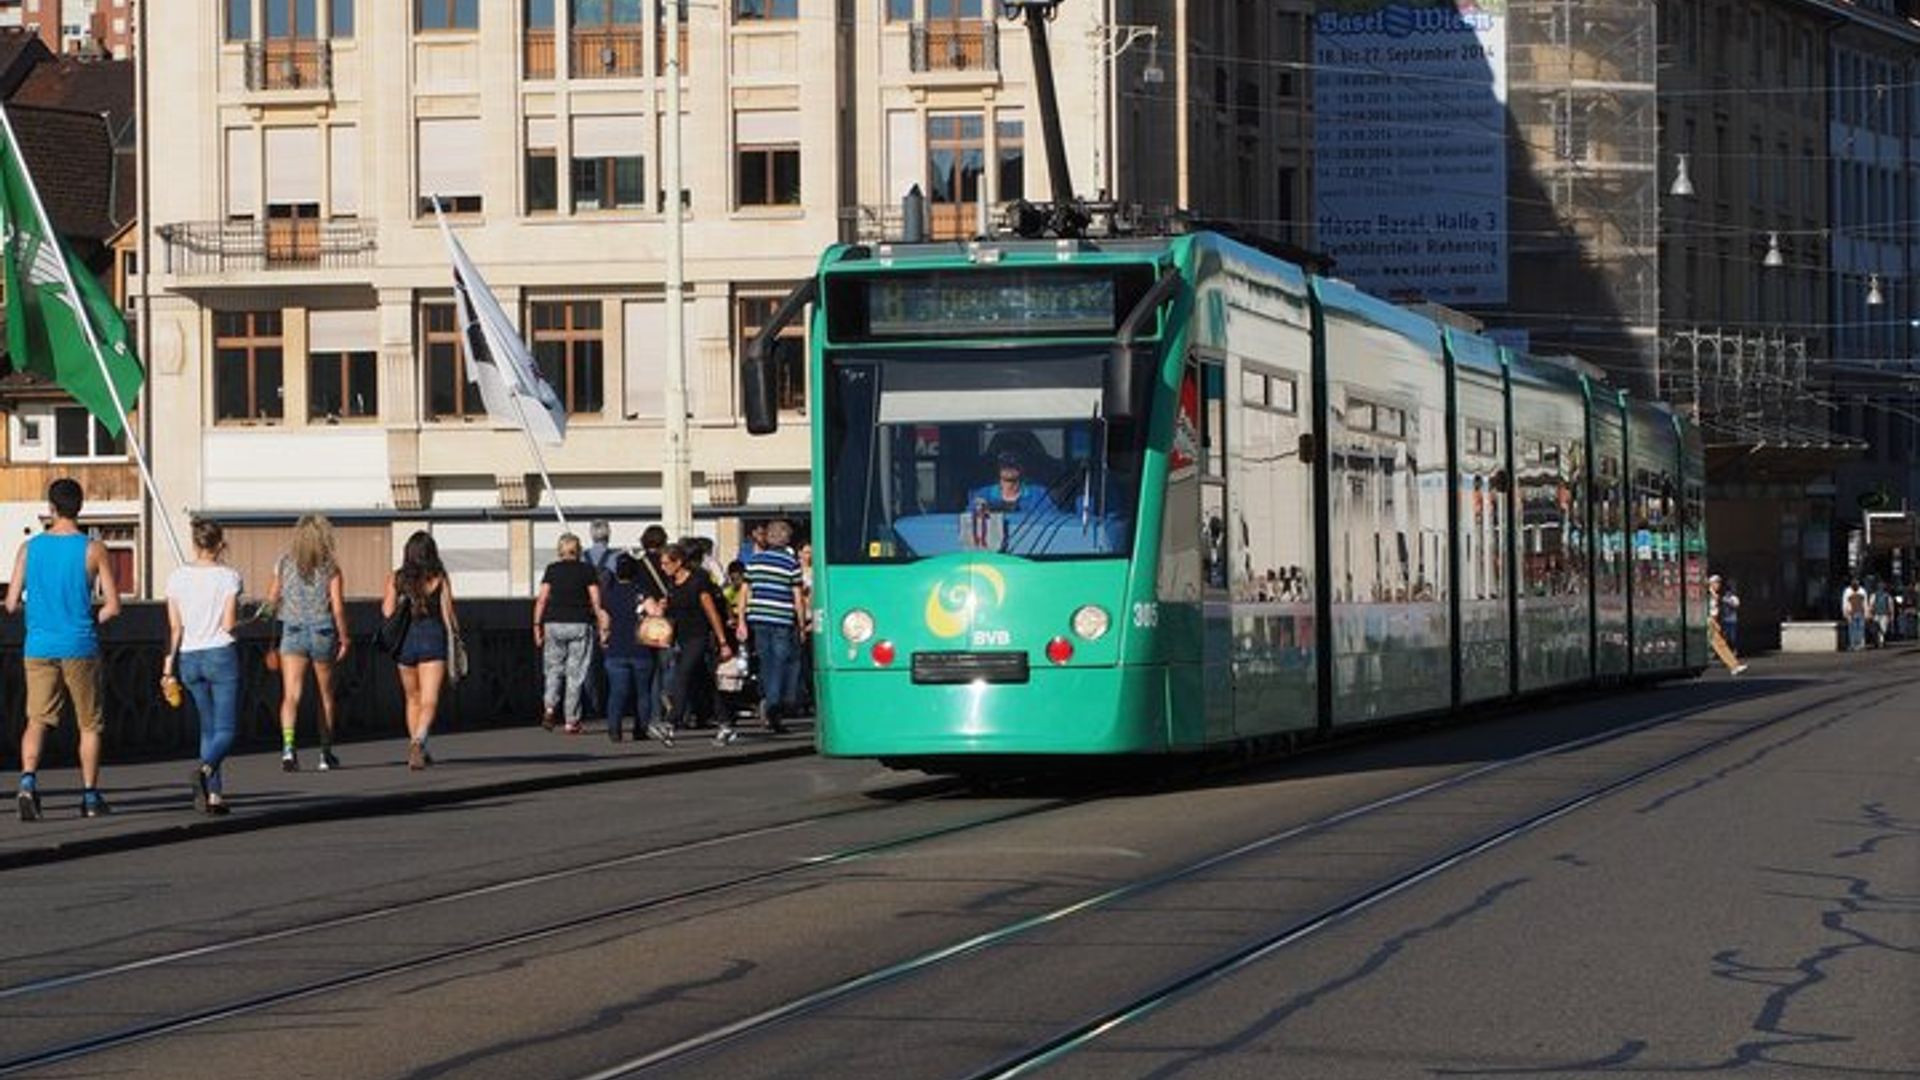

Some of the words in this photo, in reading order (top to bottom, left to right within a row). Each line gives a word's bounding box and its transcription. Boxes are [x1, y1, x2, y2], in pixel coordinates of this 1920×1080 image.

[1318, 11, 1385, 32] Basel
[1387, 46, 1455, 64] September
[1436, 211, 1479, 230] Halle
[1487, 211, 1497, 231] 3
[973, 630, 1011, 645] BVB
